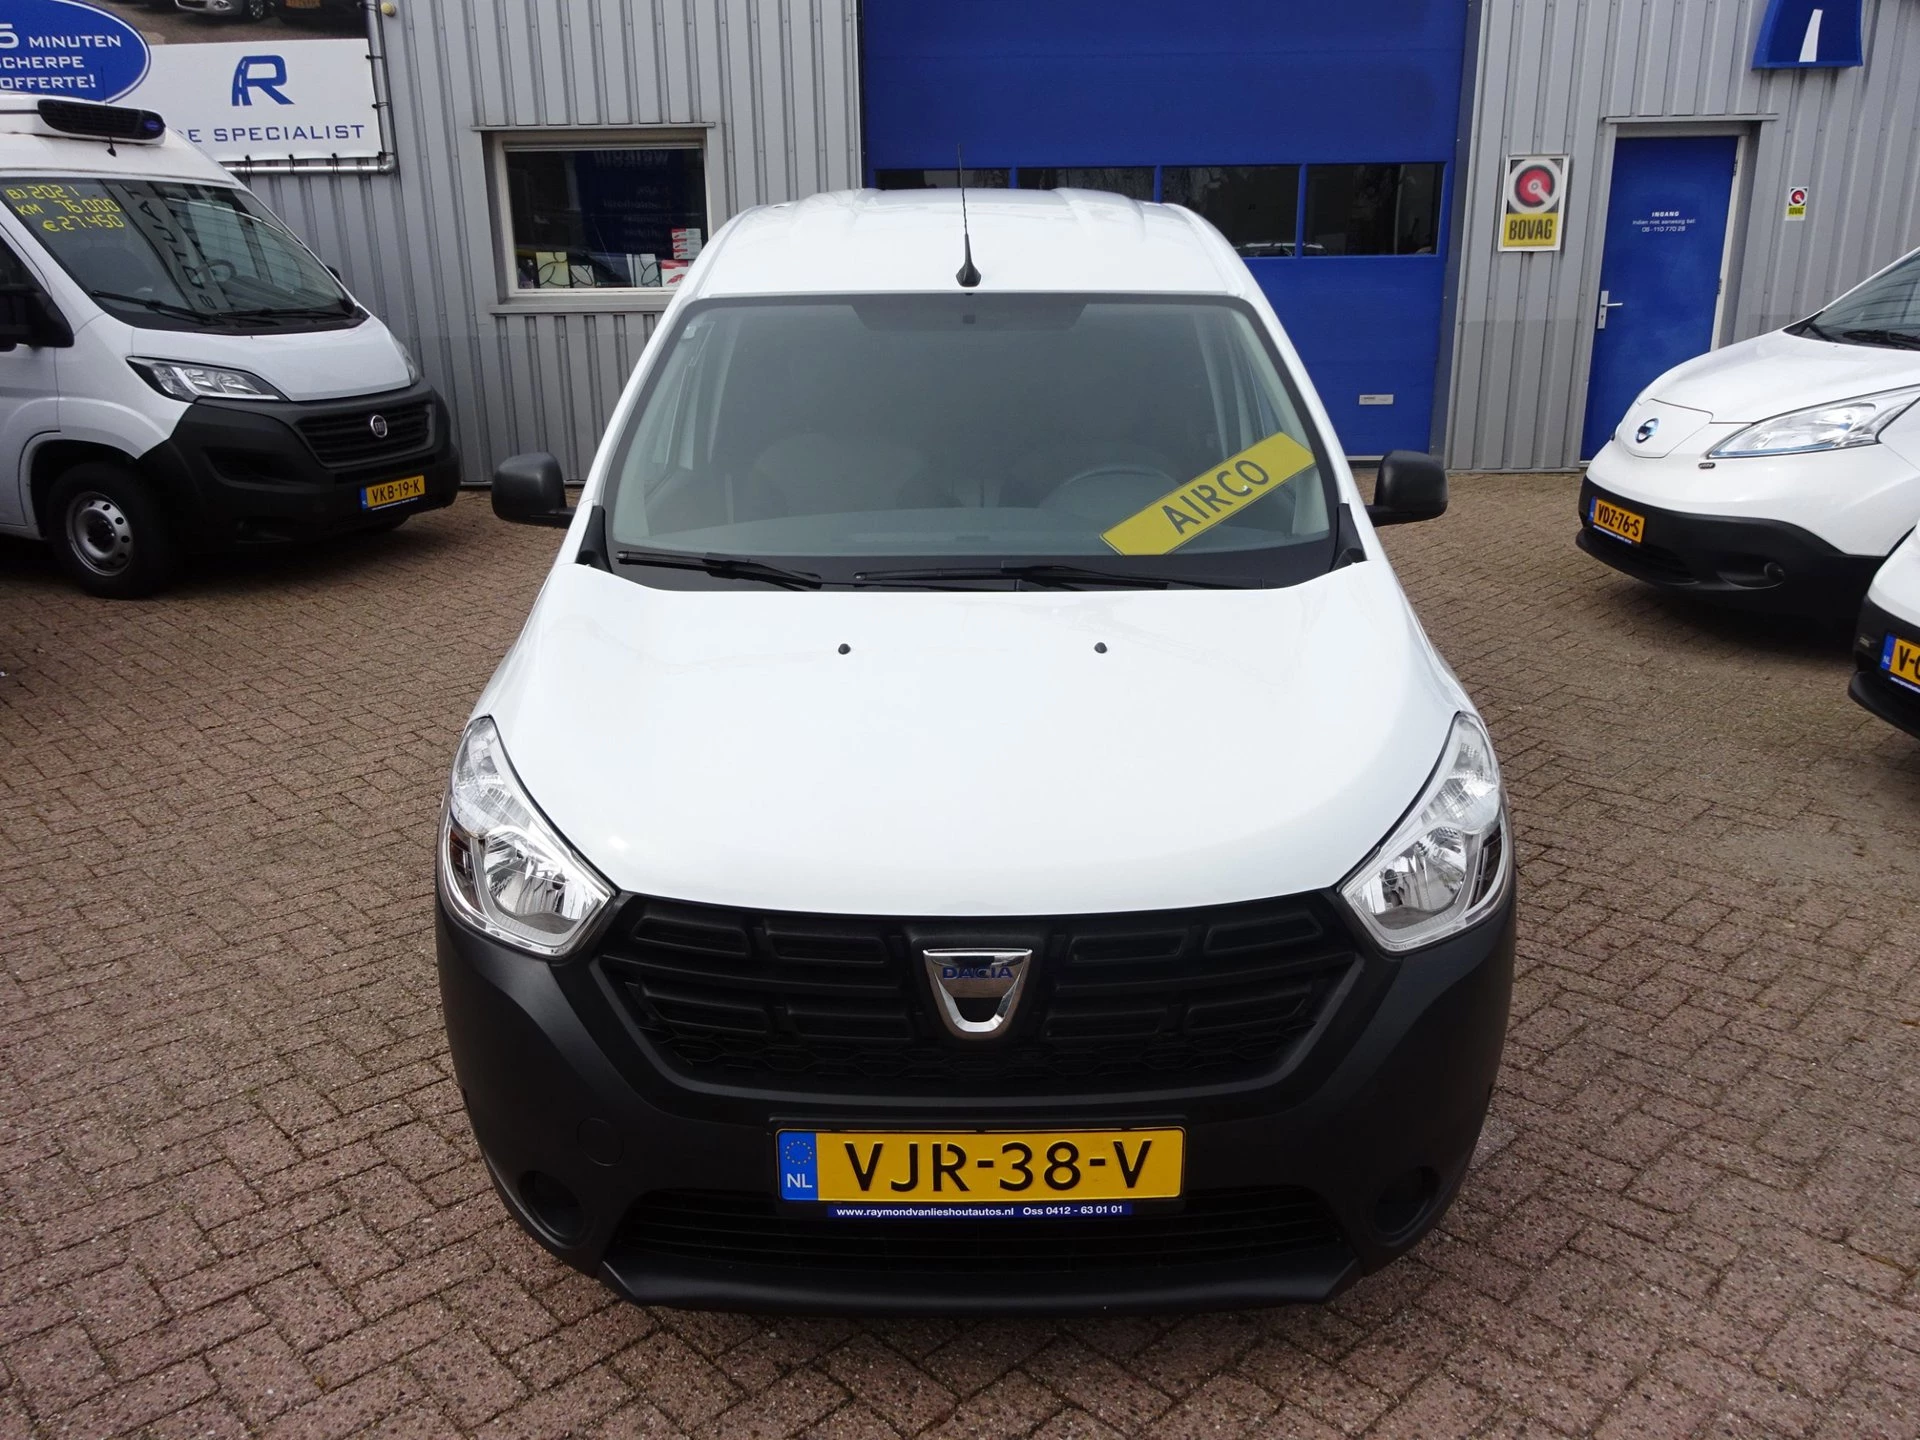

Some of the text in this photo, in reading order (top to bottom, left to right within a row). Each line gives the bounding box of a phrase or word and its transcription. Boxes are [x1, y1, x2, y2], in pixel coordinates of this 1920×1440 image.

[28, 35, 121, 48] MINUTEN
[0, 56, 84, 68] CHERPE
[0, 74, 96, 89] OFFERTE!
[214, 125, 365, 142] SPECIALIST
[15, 204, 45, 216] KM
[1508, 219, 1553, 241] BOVAG
[372, 480, 421, 503] VKB-19-K
[1161, 460, 1269, 535] AIRCO
[1598, 504, 1640, 537] VDZ-76-S
[943, 966, 1013, 979] DACIA
[844, 1139, 1153, 1192] VJR-38-V
[786, 1173, 812, 1188] NL
[836, 1207, 1014, 1217] www.raymondvanlieshoutautos.nl
[1022, 1207, 1044, 1215] Oss
[1046, 1206, 1071, 1215] 0412
[1081, 1206, 1094, 1214] 63
[1096, 1206, 1108, 1214] 01
[1111, 1205, 1123, 1213] 01
